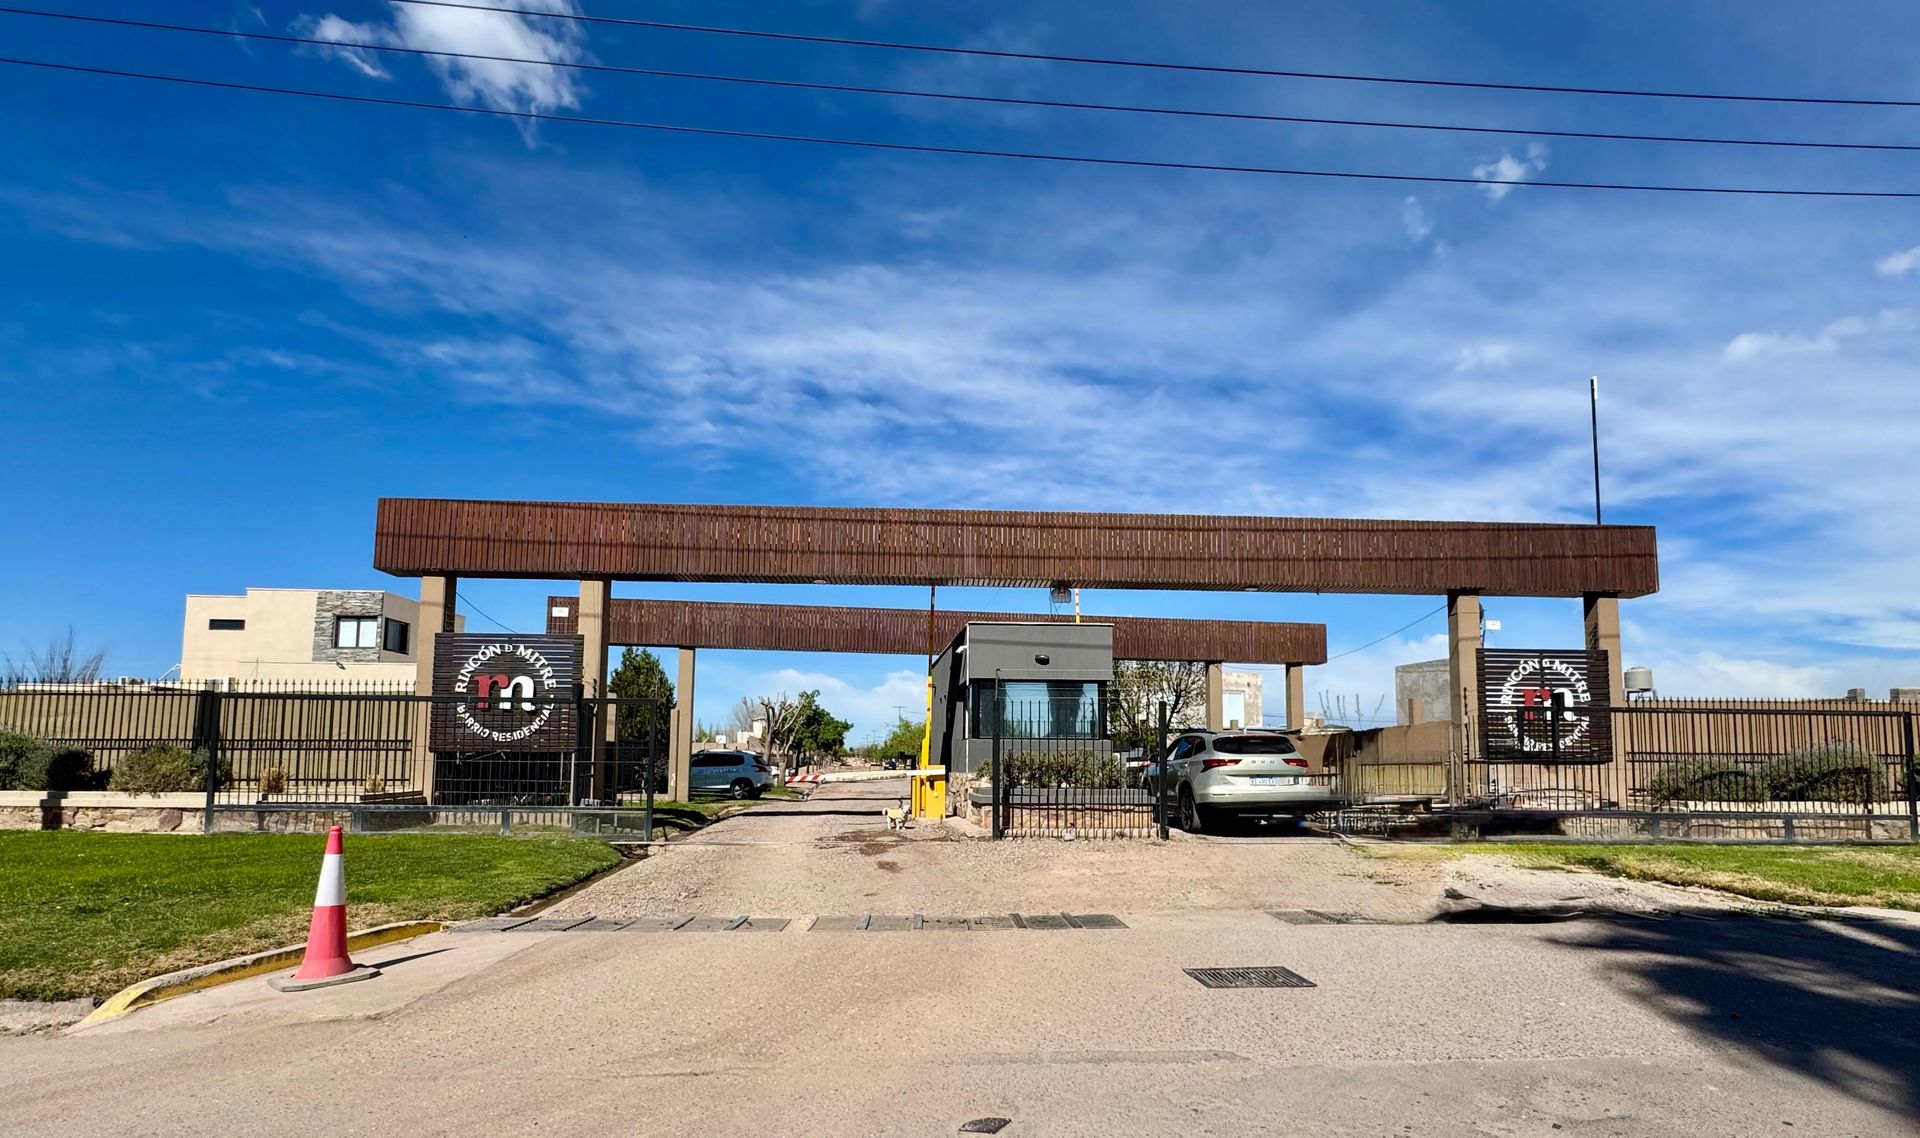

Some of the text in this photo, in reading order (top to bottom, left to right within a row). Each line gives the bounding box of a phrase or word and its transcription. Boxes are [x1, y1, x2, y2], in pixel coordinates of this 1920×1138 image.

[454, 643, 502, 693] RINCÓN
[516, 644, 557, 690] MITRE
[1552, 659, 1592, 703] MITRE
[492, 703, 555, 742] RESIDENCIAL
